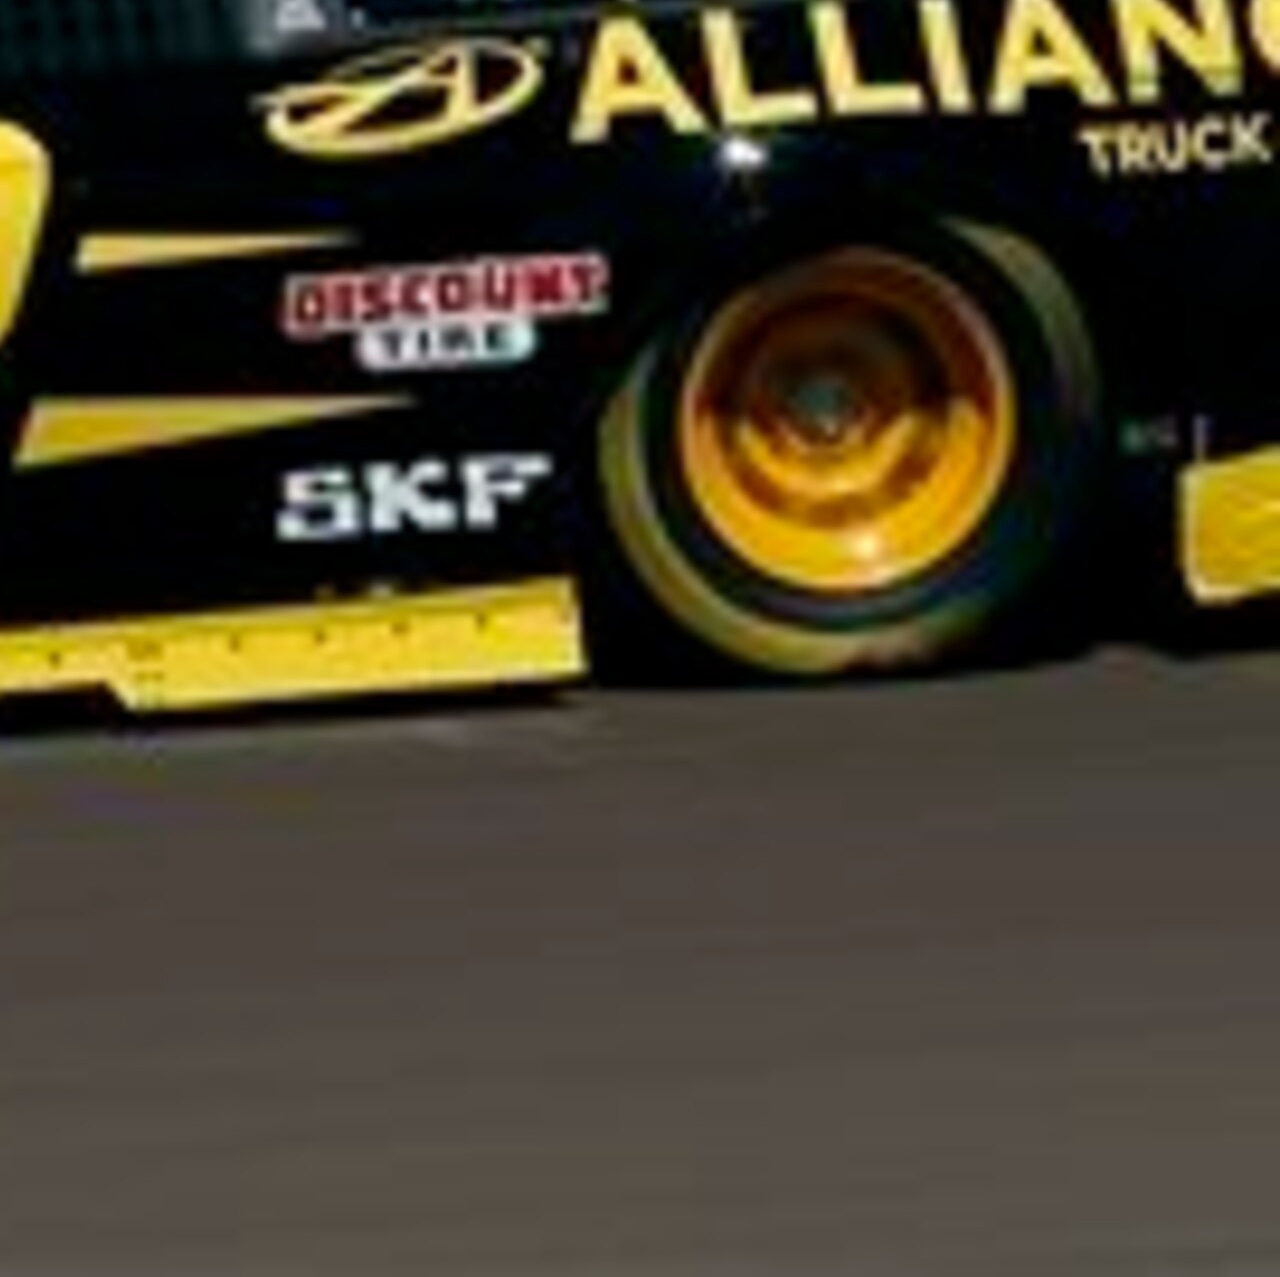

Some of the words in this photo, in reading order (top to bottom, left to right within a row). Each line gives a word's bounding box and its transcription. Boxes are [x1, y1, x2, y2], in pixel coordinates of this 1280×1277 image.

[1077, 111, 1273, 178] TRUCK
[286, 251, 610, 337] DISCOUNT
[372, 323, 524, 363] TIRE
[275, 452, 552, 541] SKF
